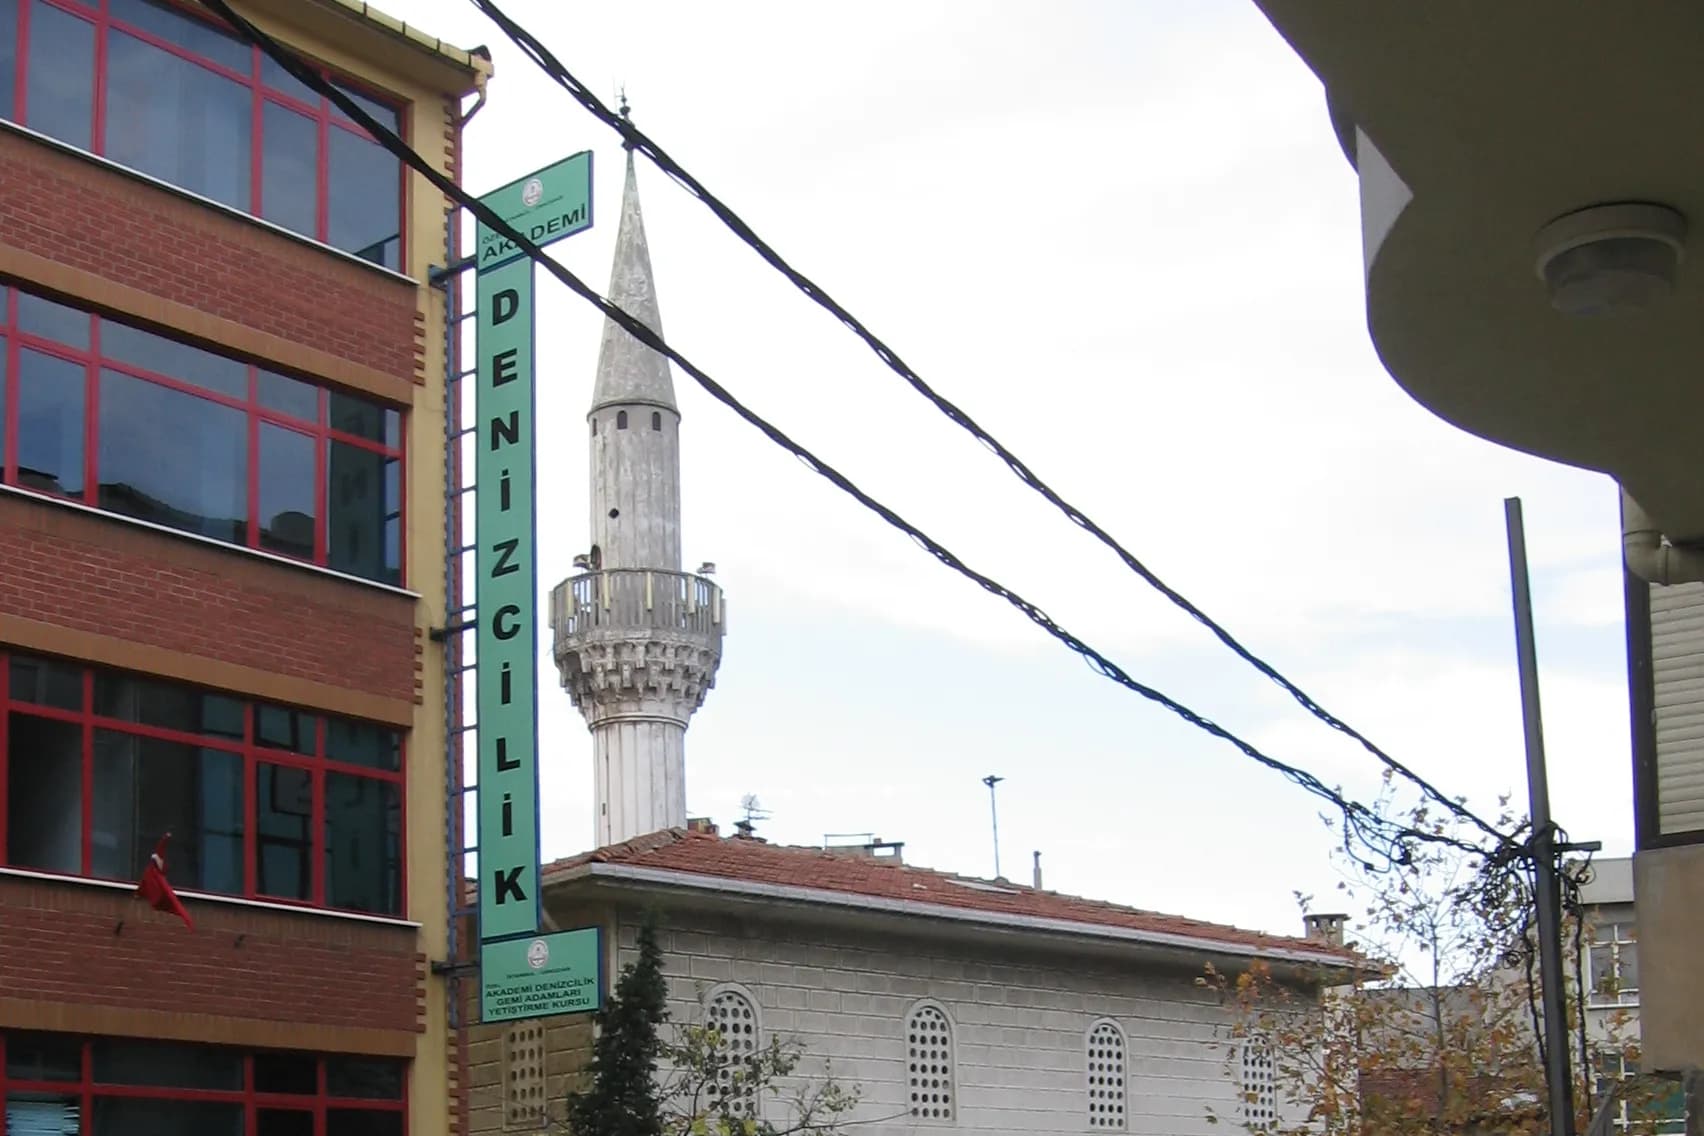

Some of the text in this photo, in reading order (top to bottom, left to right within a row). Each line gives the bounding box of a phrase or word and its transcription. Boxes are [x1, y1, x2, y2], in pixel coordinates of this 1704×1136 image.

[489, 286, 527, 907] DENİZCİLİK
[486, 985, 532, 998] AKADEMİ
[525, 988, 582, 1002] ADAMLARI
[552, 997, 590, 1009] KURSU
